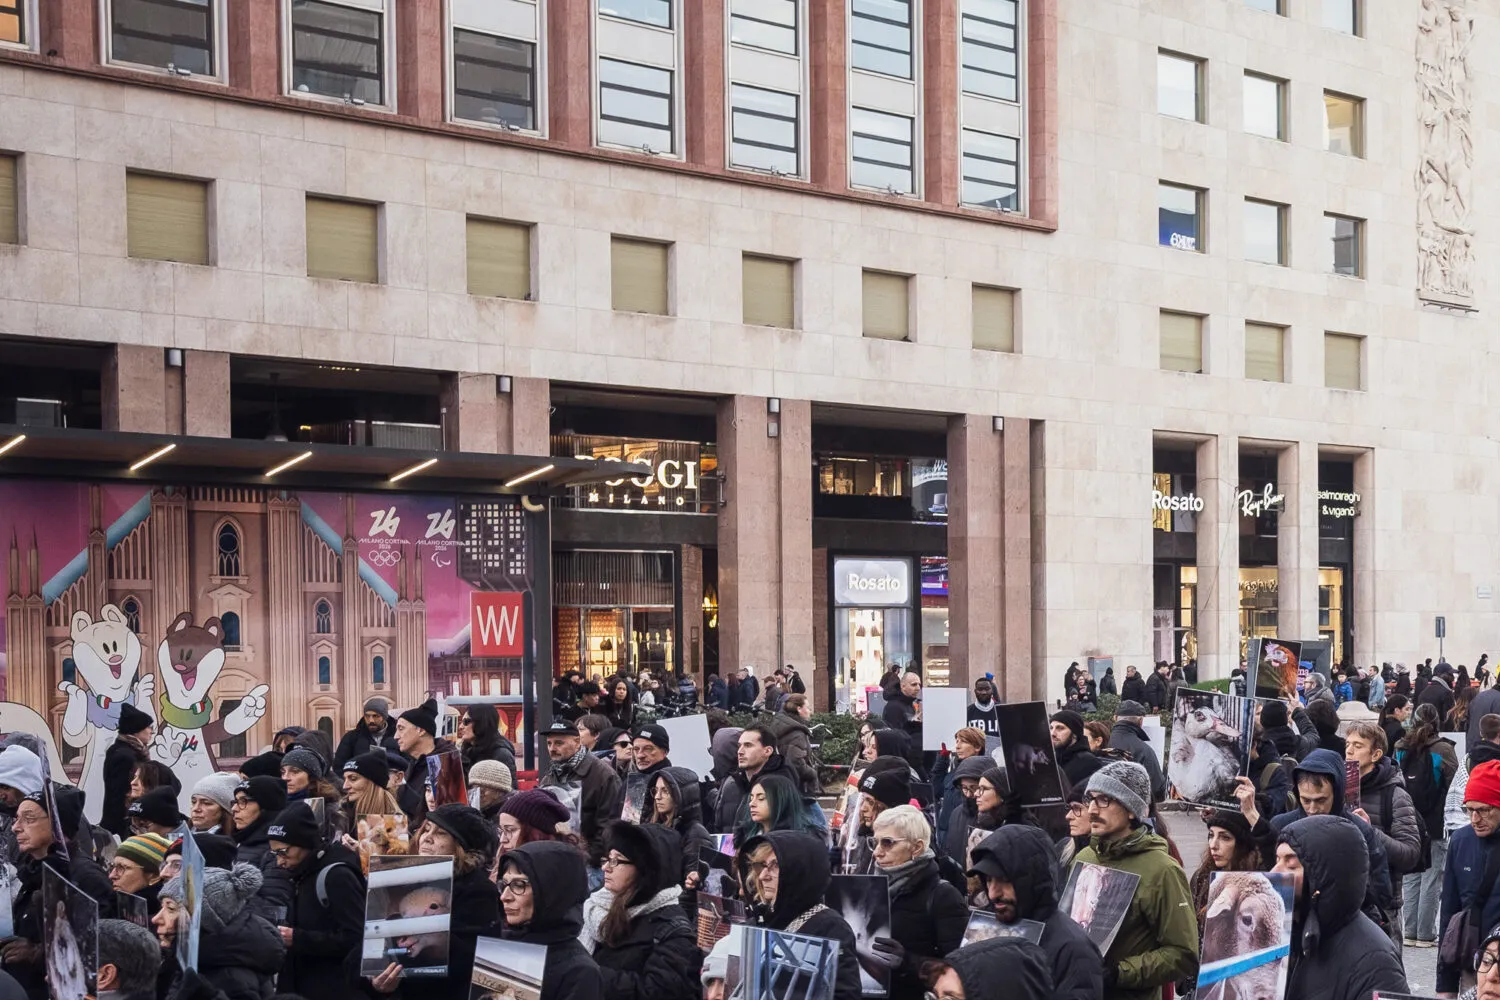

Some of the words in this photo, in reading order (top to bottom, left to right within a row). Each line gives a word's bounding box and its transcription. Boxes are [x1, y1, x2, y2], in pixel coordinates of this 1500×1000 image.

[588, 492, 686, 506] MILANO
[1151, 490, 1205, 512] Rosato
[358, 537, 384, 545] MILANO
[848, 573, 901, 591] Rosato
